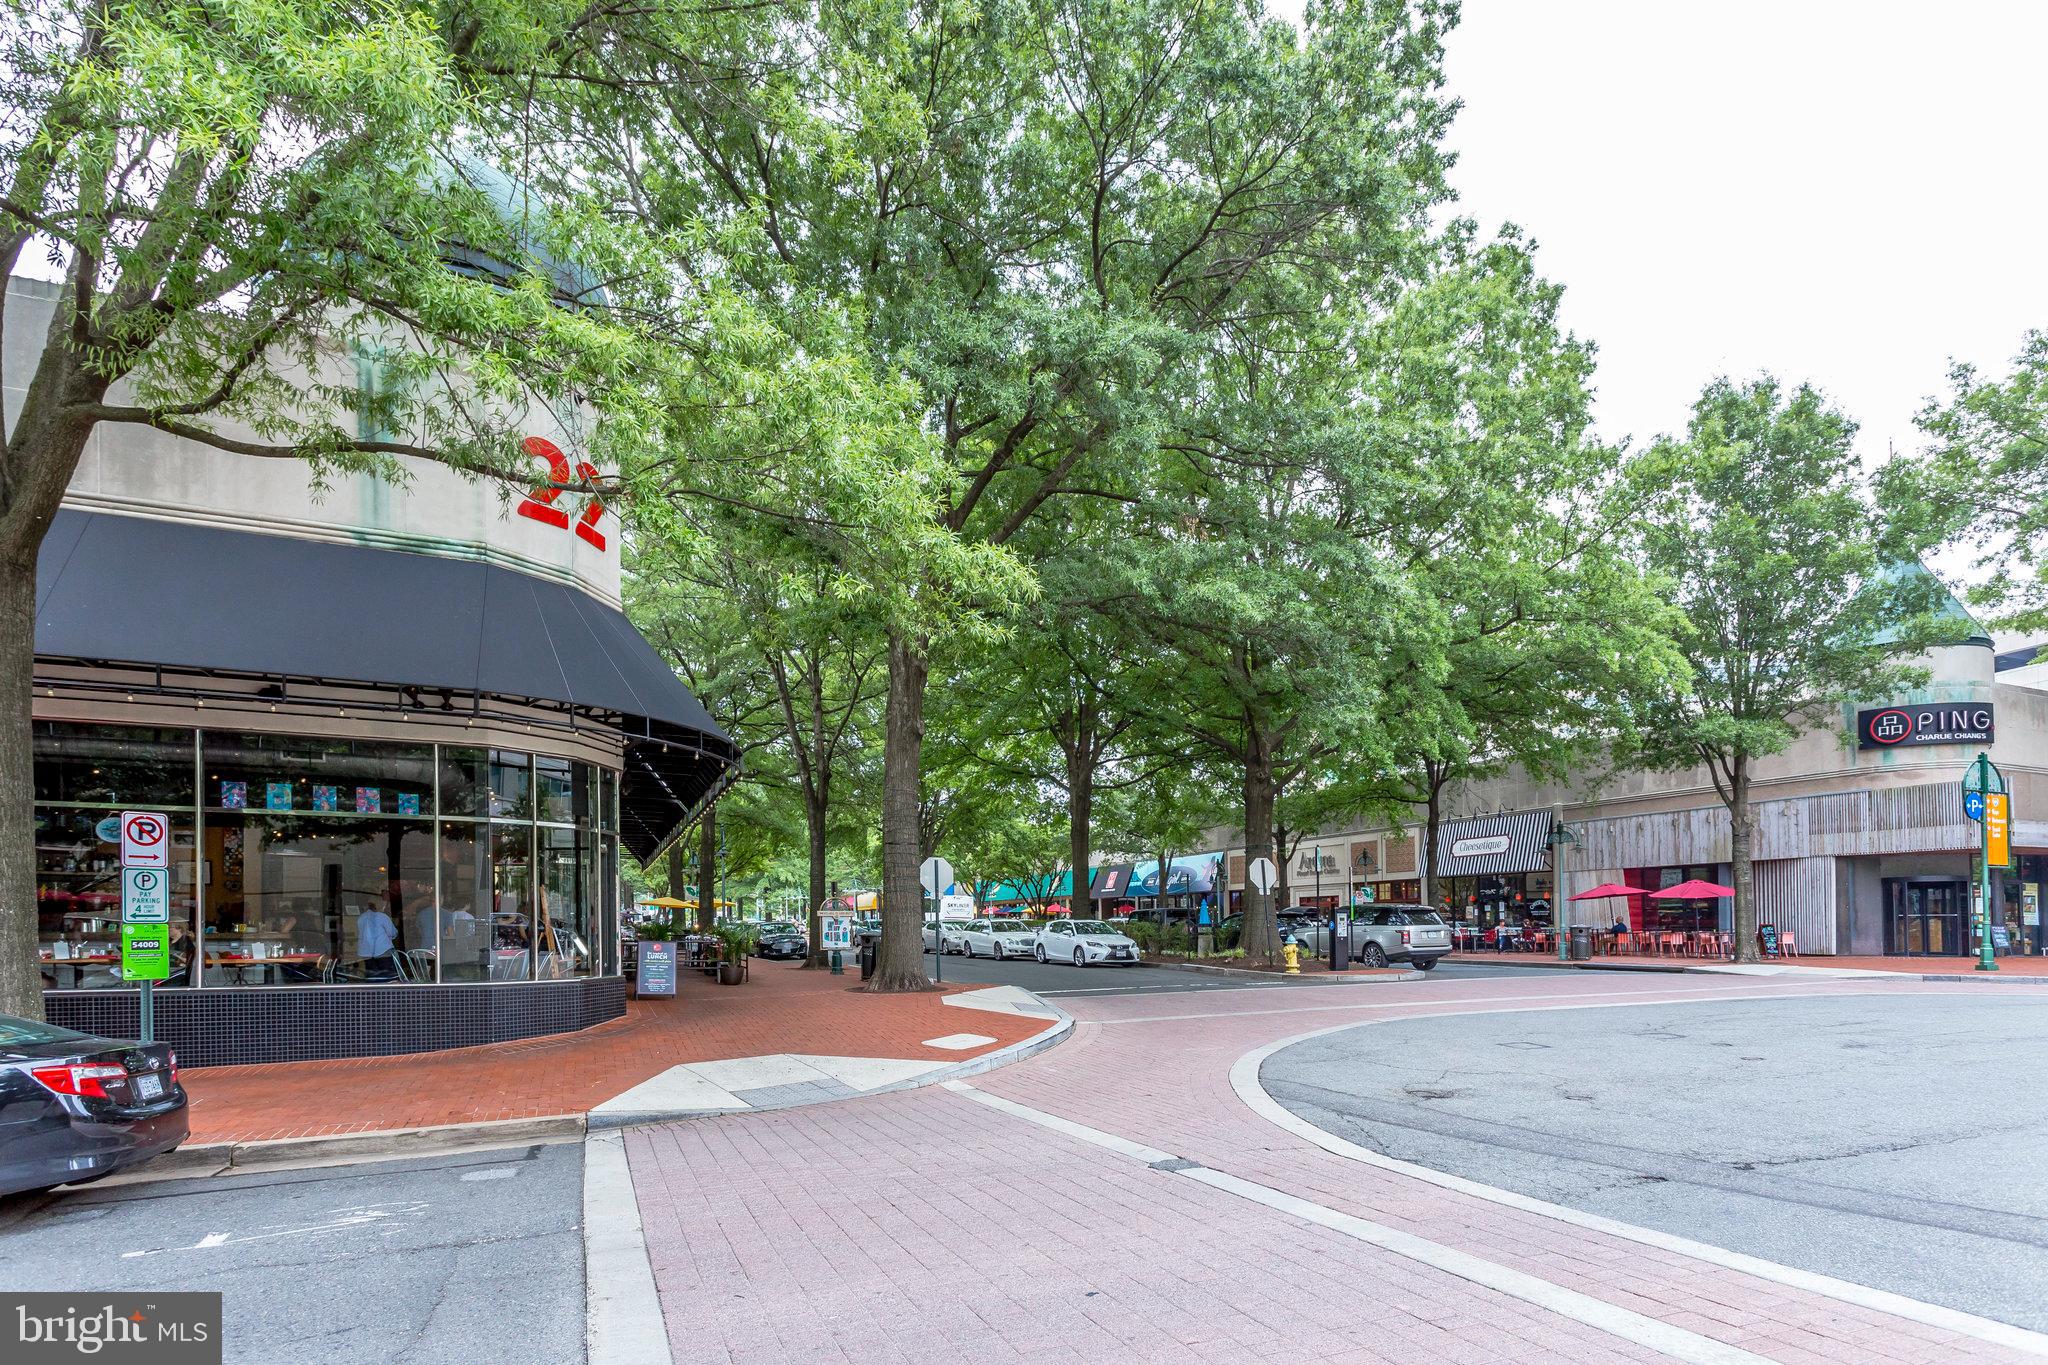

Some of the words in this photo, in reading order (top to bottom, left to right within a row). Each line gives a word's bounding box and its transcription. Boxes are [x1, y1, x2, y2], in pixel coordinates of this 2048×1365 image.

[1918, 710, 1991, 731] PING
[1878, 716, 1903, 737] 品
[1916, 733, 1952, 741] CHARLIE
[1459, 841, 1502, 852] Cheesetique
[135, 905, 141, 914] 4
[132, 941, 159, 949] 54009
